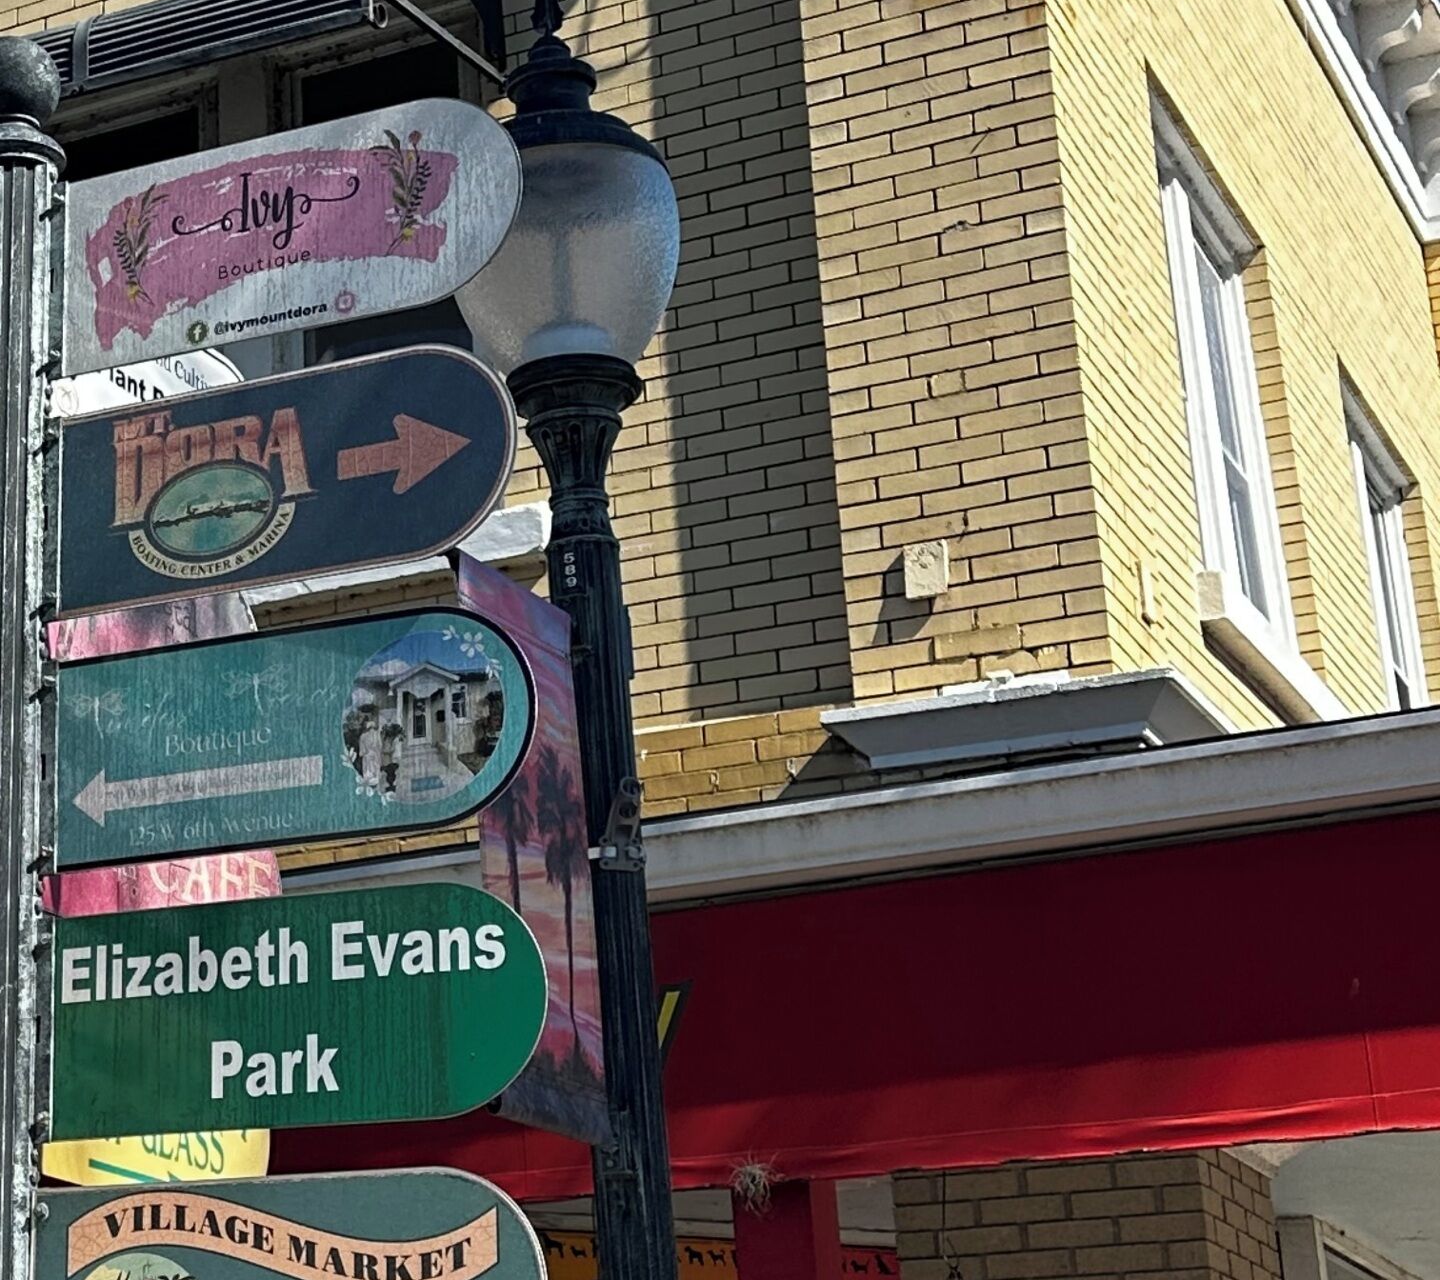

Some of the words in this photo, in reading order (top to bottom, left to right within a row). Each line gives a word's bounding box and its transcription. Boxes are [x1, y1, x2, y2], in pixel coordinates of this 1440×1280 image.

[172, 172, 360, 250] Ivy
[217, 250, 312, 280] Boutique
[213, 303, 329, 336] @ivymountdora
[109, 406, 320, 534] DORA
[131, 535, 177, 576] BOATING
[180, 554, 233, 577] CENTER
[234, 554, 246, 566] &
[247, 509, 292, 559] MARINA
[563, 552, 577, 588] 589
[164, 725, 273, 757] Boutique
[182, 816, 215, 840] 6th
[61, 924, 309, 1006] Elizabeth
[330, 918, 507, 981] Evans
[209, 1033, 340, 1100] Park
[102, 1202, 275, 1257] VILLAGE
